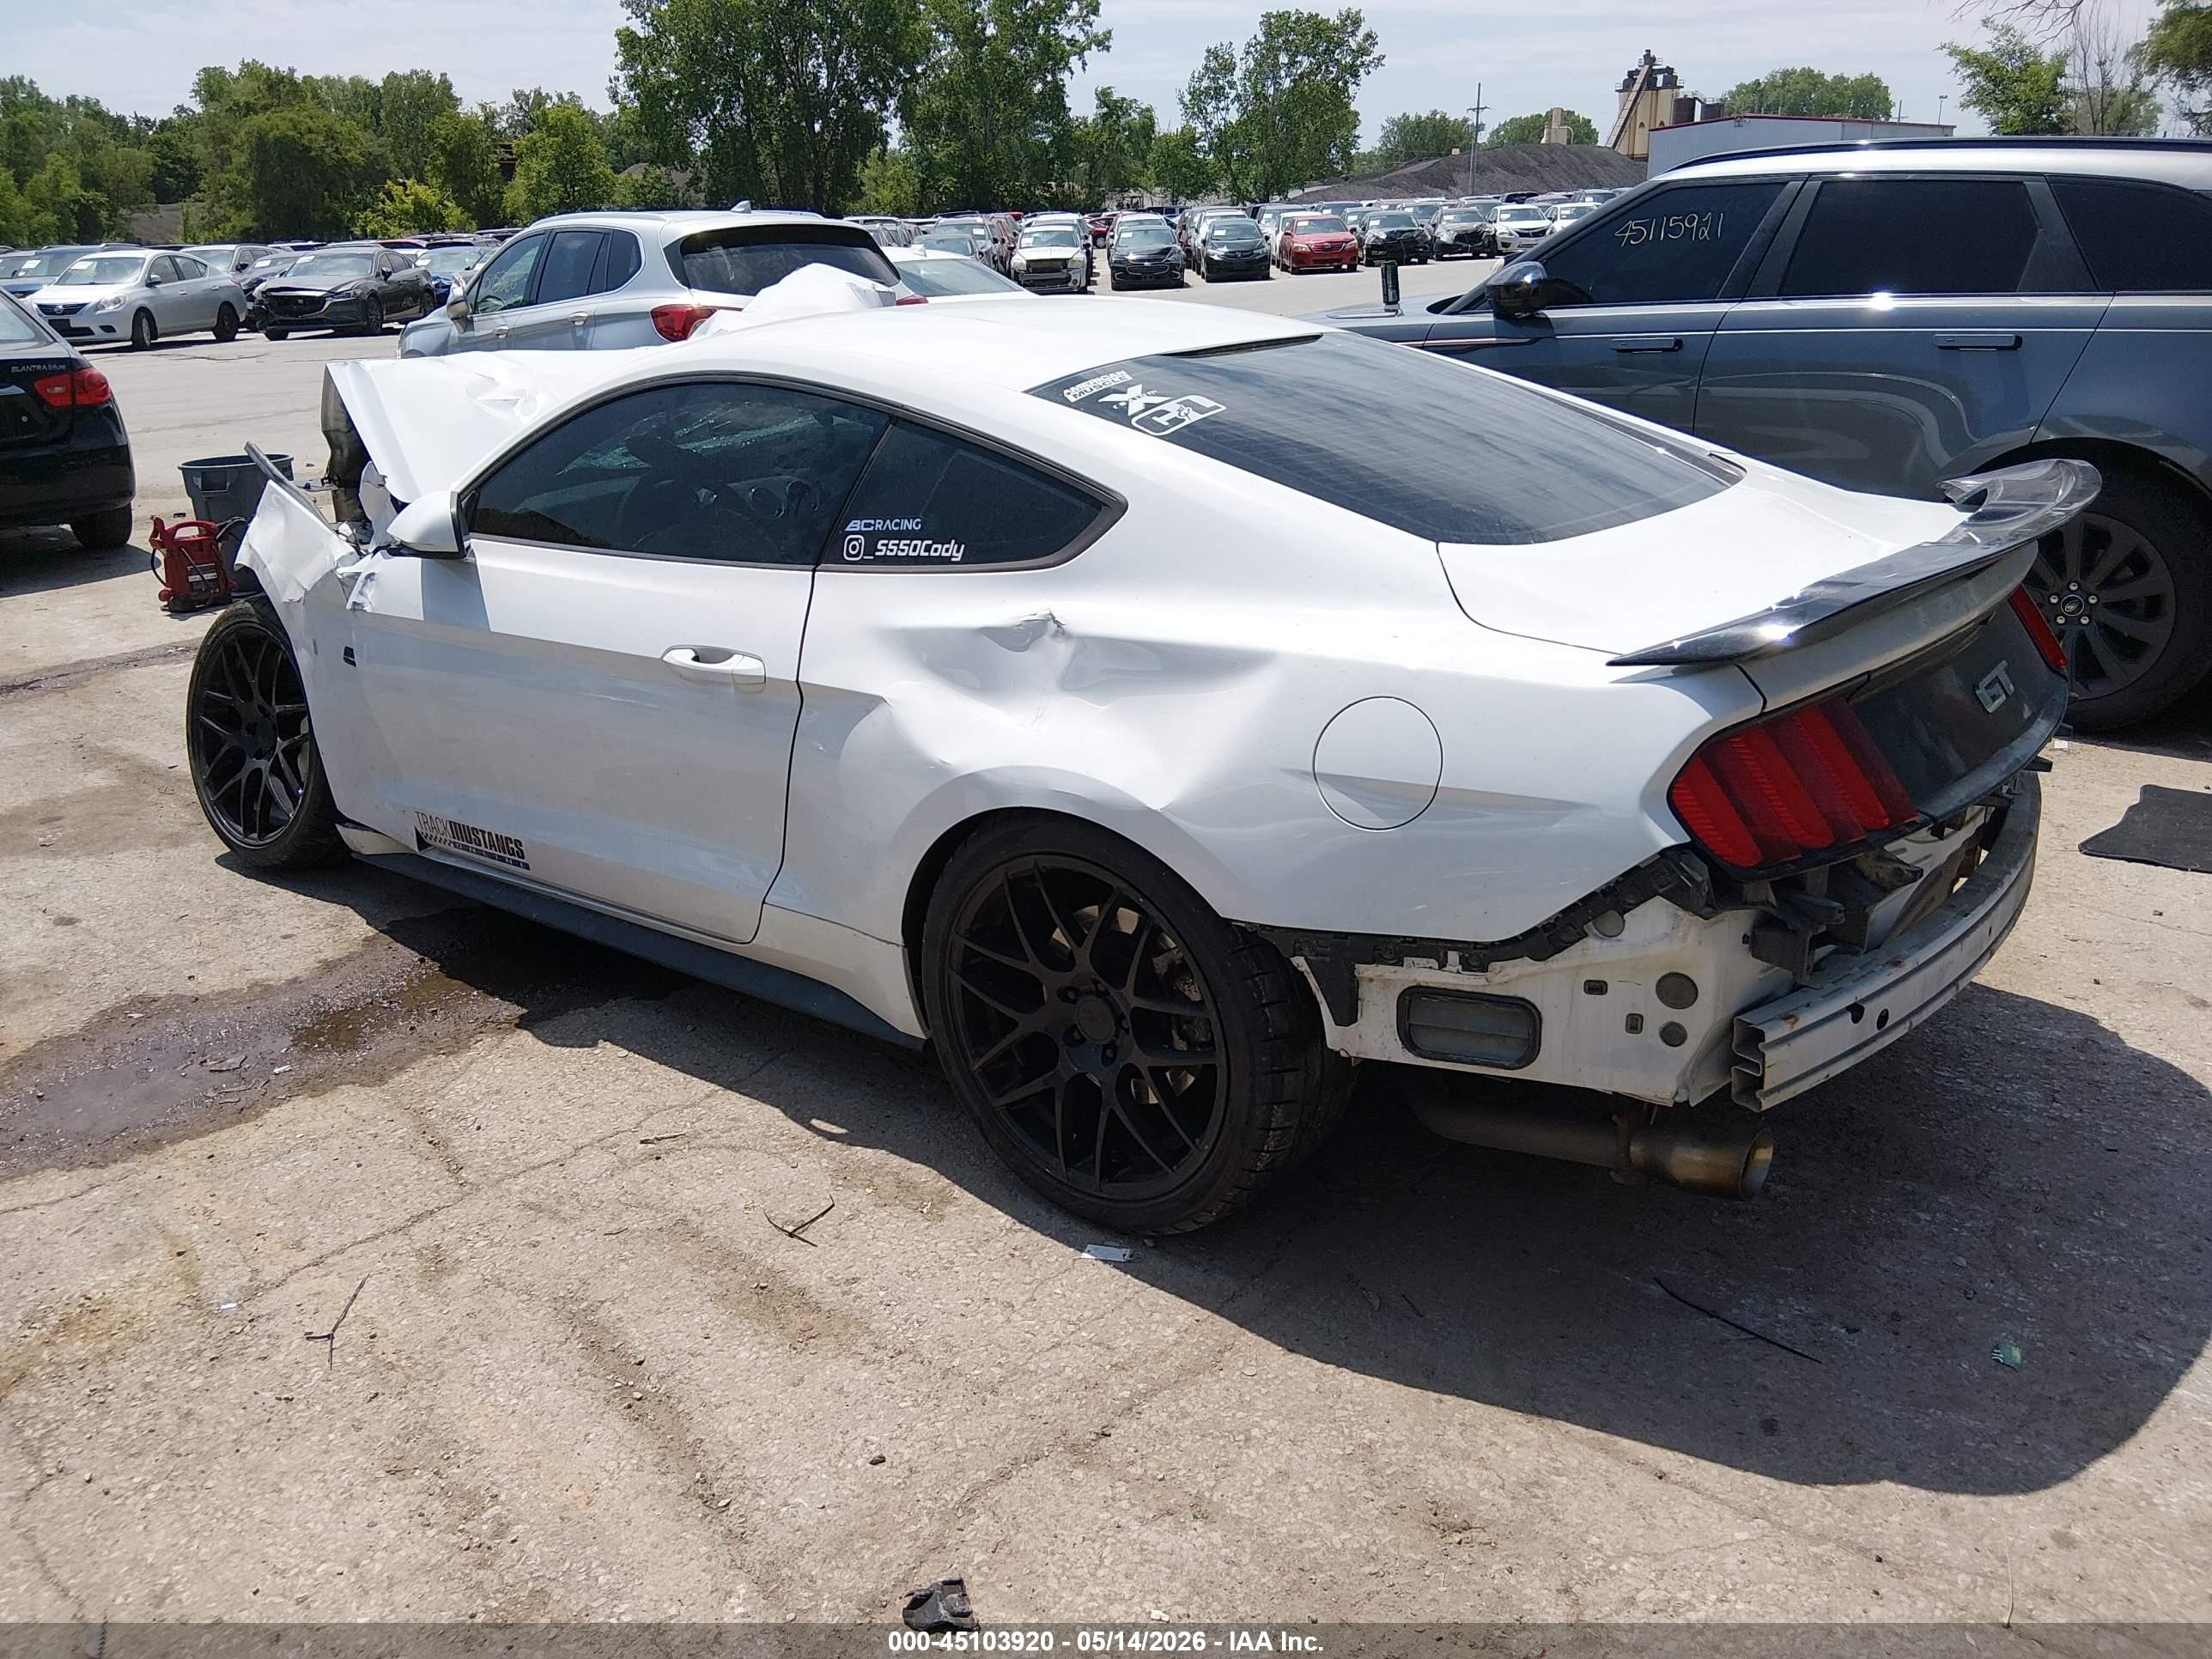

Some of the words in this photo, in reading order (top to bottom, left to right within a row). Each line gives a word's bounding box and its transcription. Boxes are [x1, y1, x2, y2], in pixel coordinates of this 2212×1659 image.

[1613, 211, 1724, 247] 45115921
[11, 364, 47, 374] ELANTRA
[1064, 370, 1129, 395] AMERICAN
[1073, 376, 1129, 399] MUSCLE
[1975, 659, 2014, 714] GT
